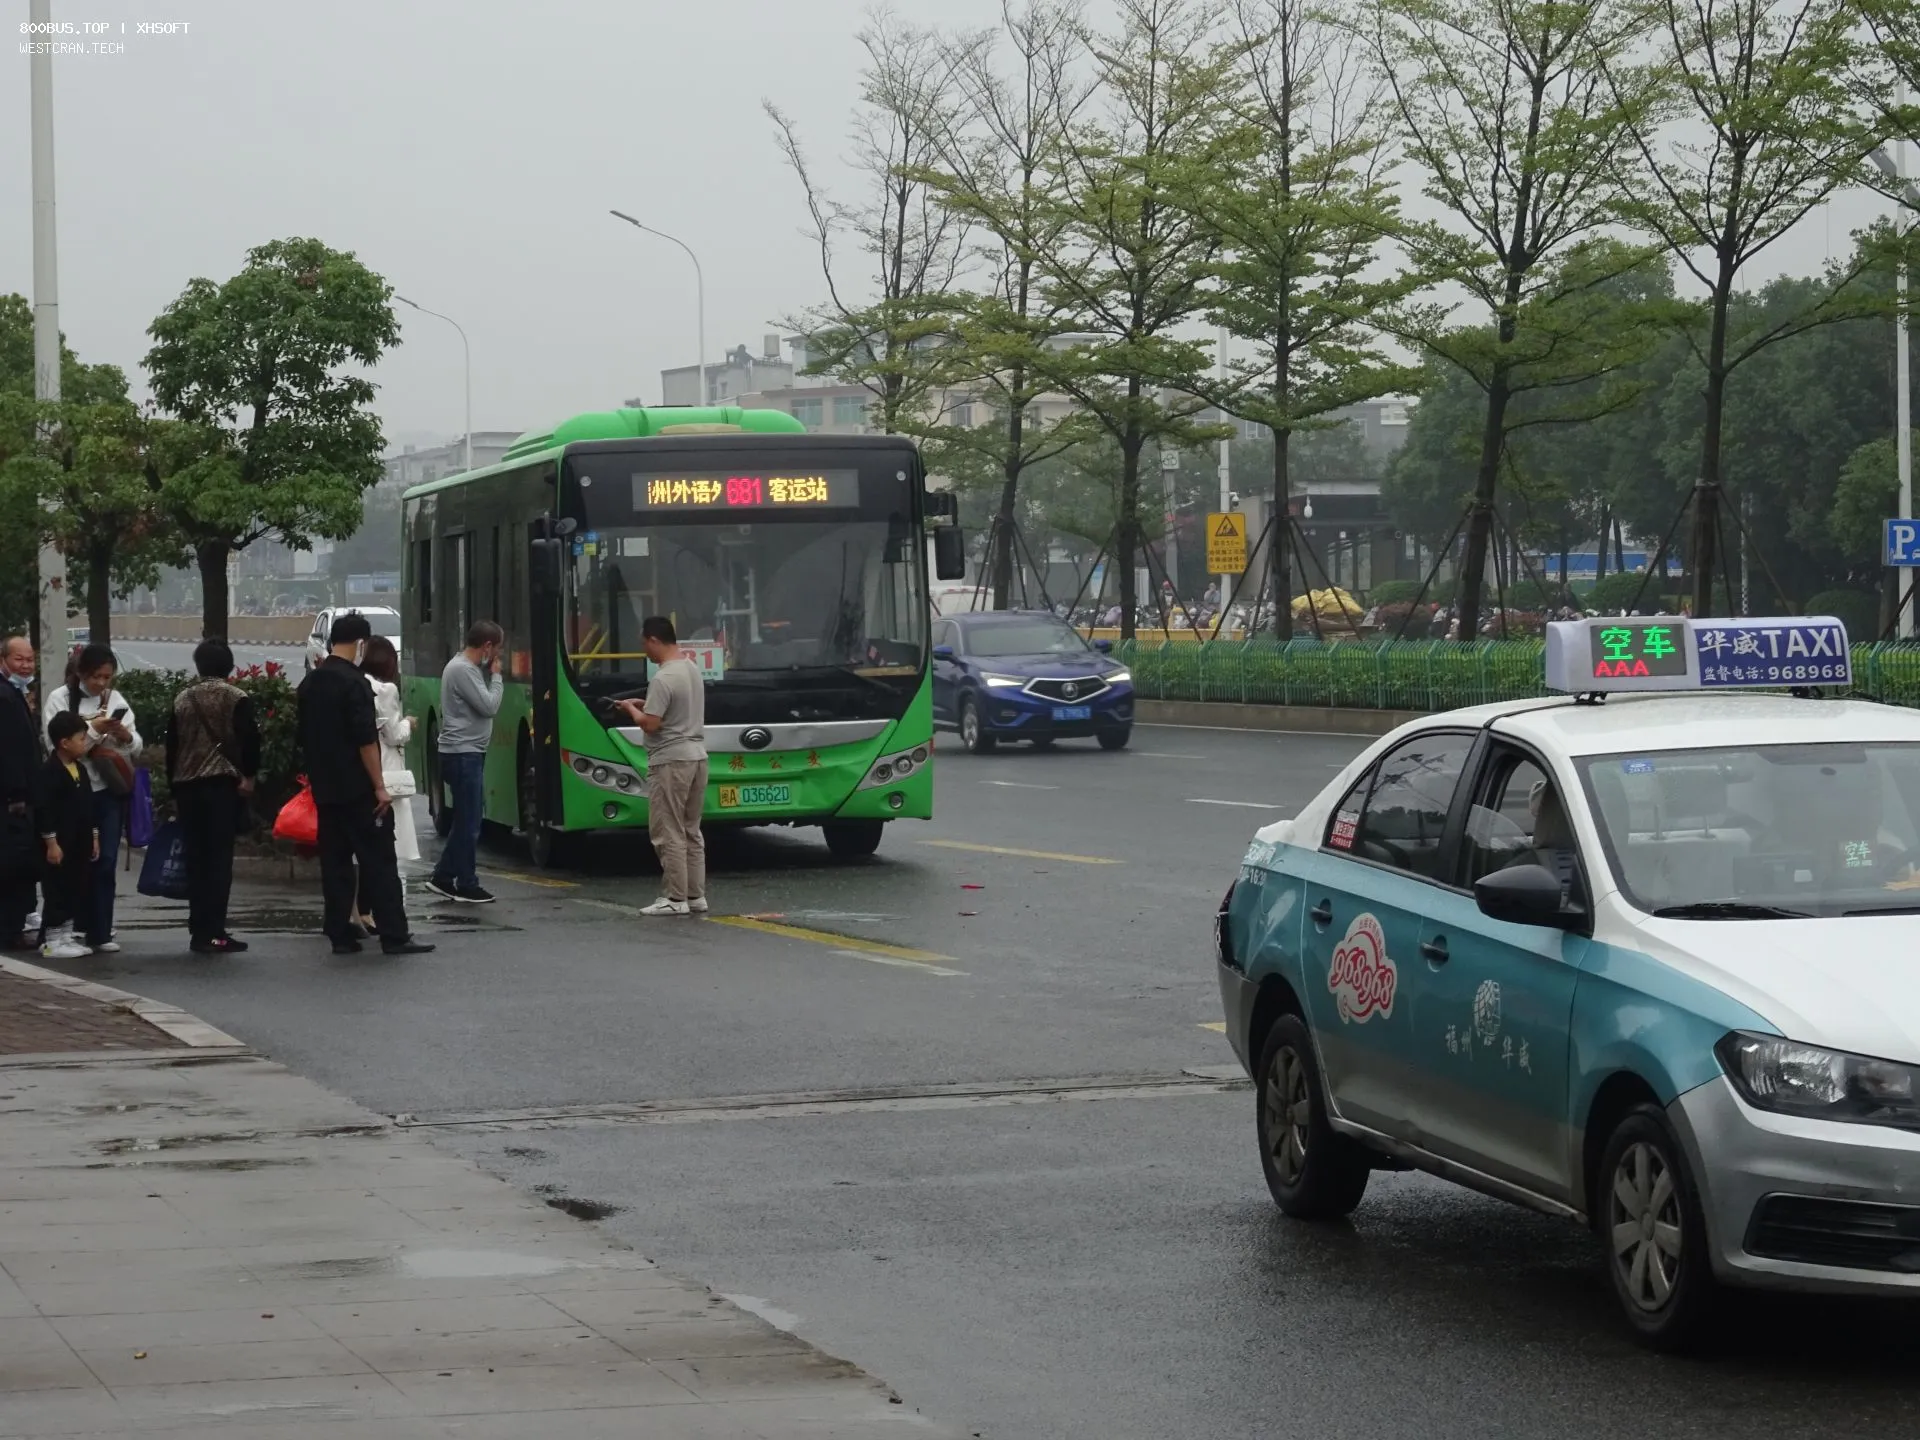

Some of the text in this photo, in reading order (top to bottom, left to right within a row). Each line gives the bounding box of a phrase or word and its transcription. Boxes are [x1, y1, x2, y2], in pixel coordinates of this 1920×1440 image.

[726, 476, 763, 505] 681
[768, 476, 828, 502] 客运站
[1893, 525, 1916, 560] P
[1600, 625, 1676, 661] 空车
[1594, 659, 1649, 677] AAA
[1844, 840, 1872, 861] 空车
[1330, 947, 1394, 1010] 968968
